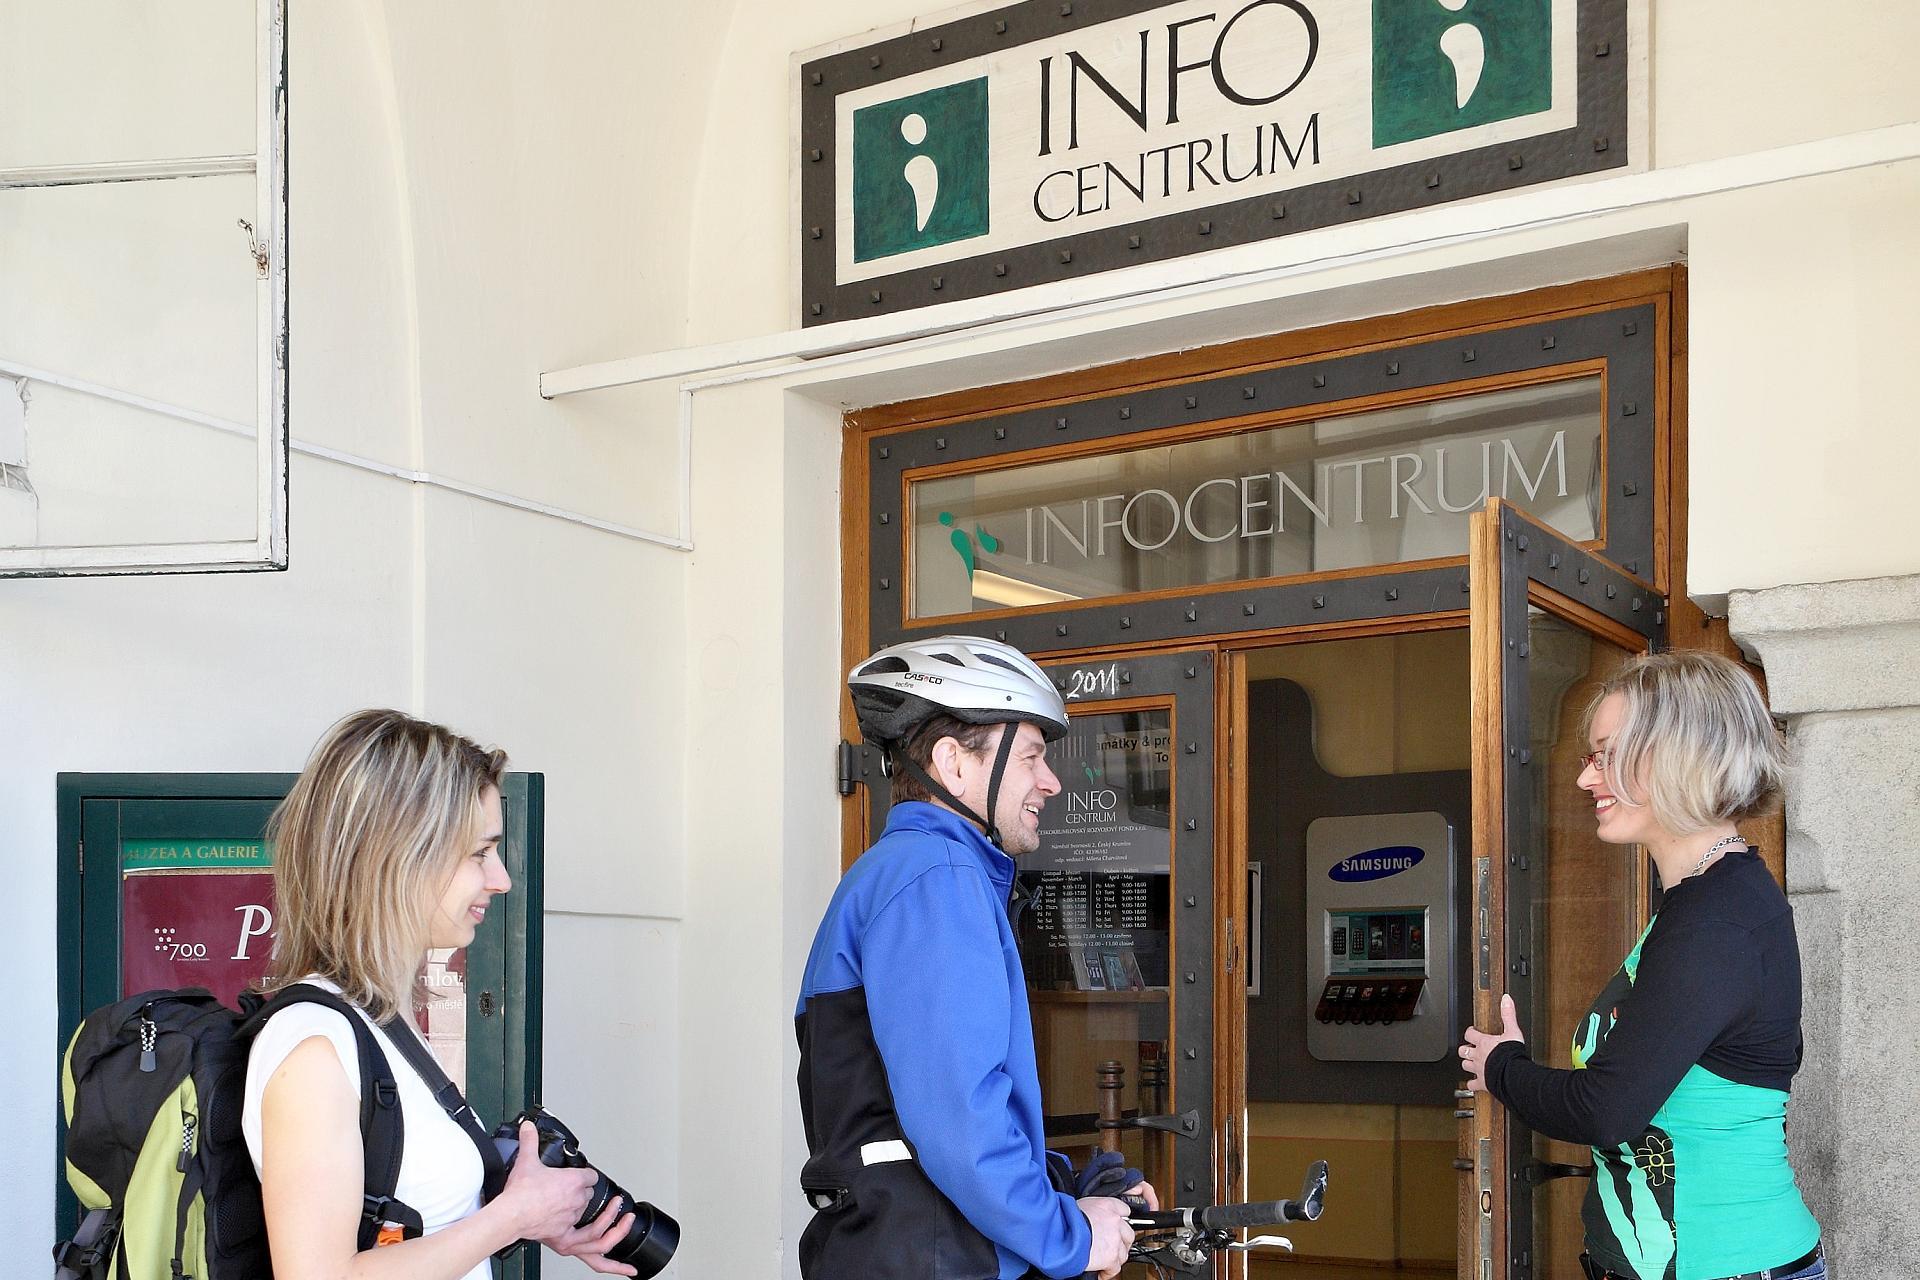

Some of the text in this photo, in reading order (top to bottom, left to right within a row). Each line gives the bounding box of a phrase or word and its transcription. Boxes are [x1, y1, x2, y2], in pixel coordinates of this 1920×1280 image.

[1038, 0, 1320, 157] INFO
[1033, 112, 1321, 222] CENTRUM
[1025, 429, 1569, 565] INFOCENTRUM
[1066, 663, 1116, 699] 2011
[1142, 736, 1150, 747] &
[1067, 790, 1117, 812] INFO
[1066, 812, 1116, 824] CENTRUM
[182, 846, 192, 858] A
[197, 845, 258, 858] GALERIE
[1341, 856, 1412, 872] SAMSUNG
[169, 943, 207, 961] 700
